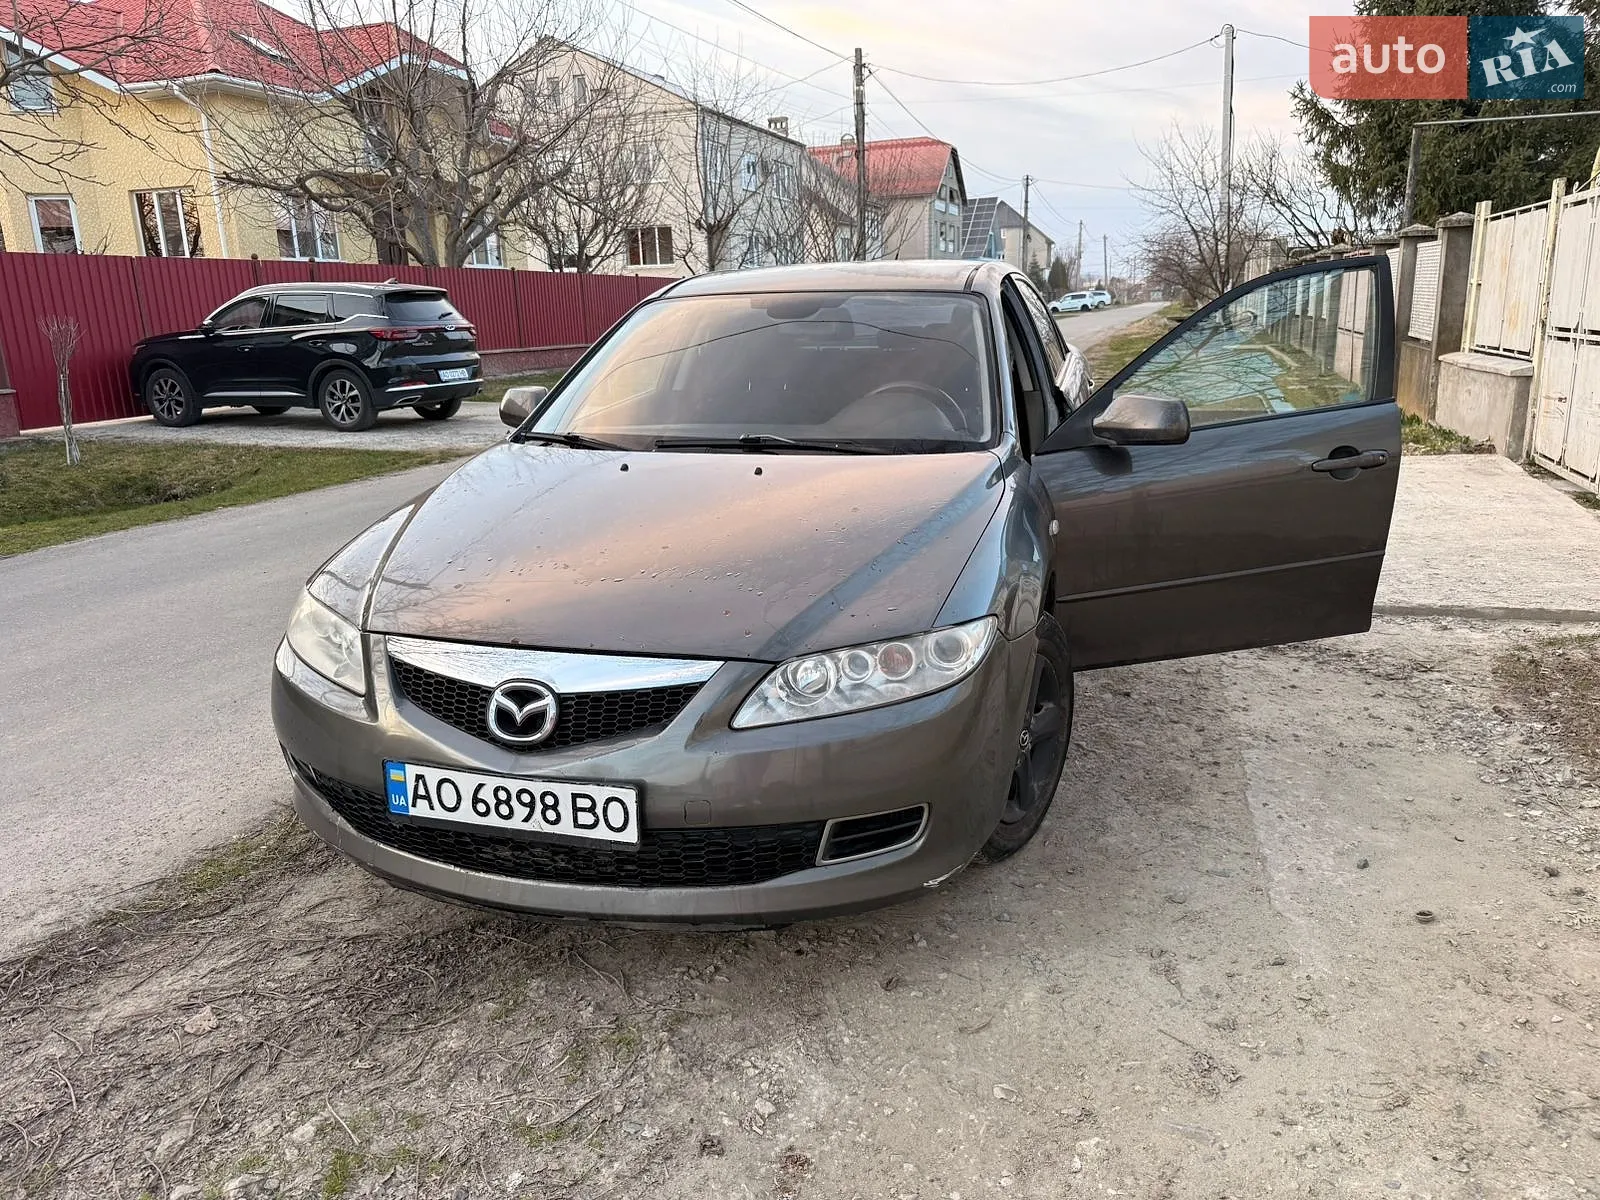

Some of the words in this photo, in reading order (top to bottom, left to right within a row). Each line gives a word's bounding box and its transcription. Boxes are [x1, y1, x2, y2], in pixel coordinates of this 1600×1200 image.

[391, 793, 408, 807] UA
[411, 773, 462, 813] AO
[472, 782, 562, 826] 6898
[571, 792, 630, 833] BO
